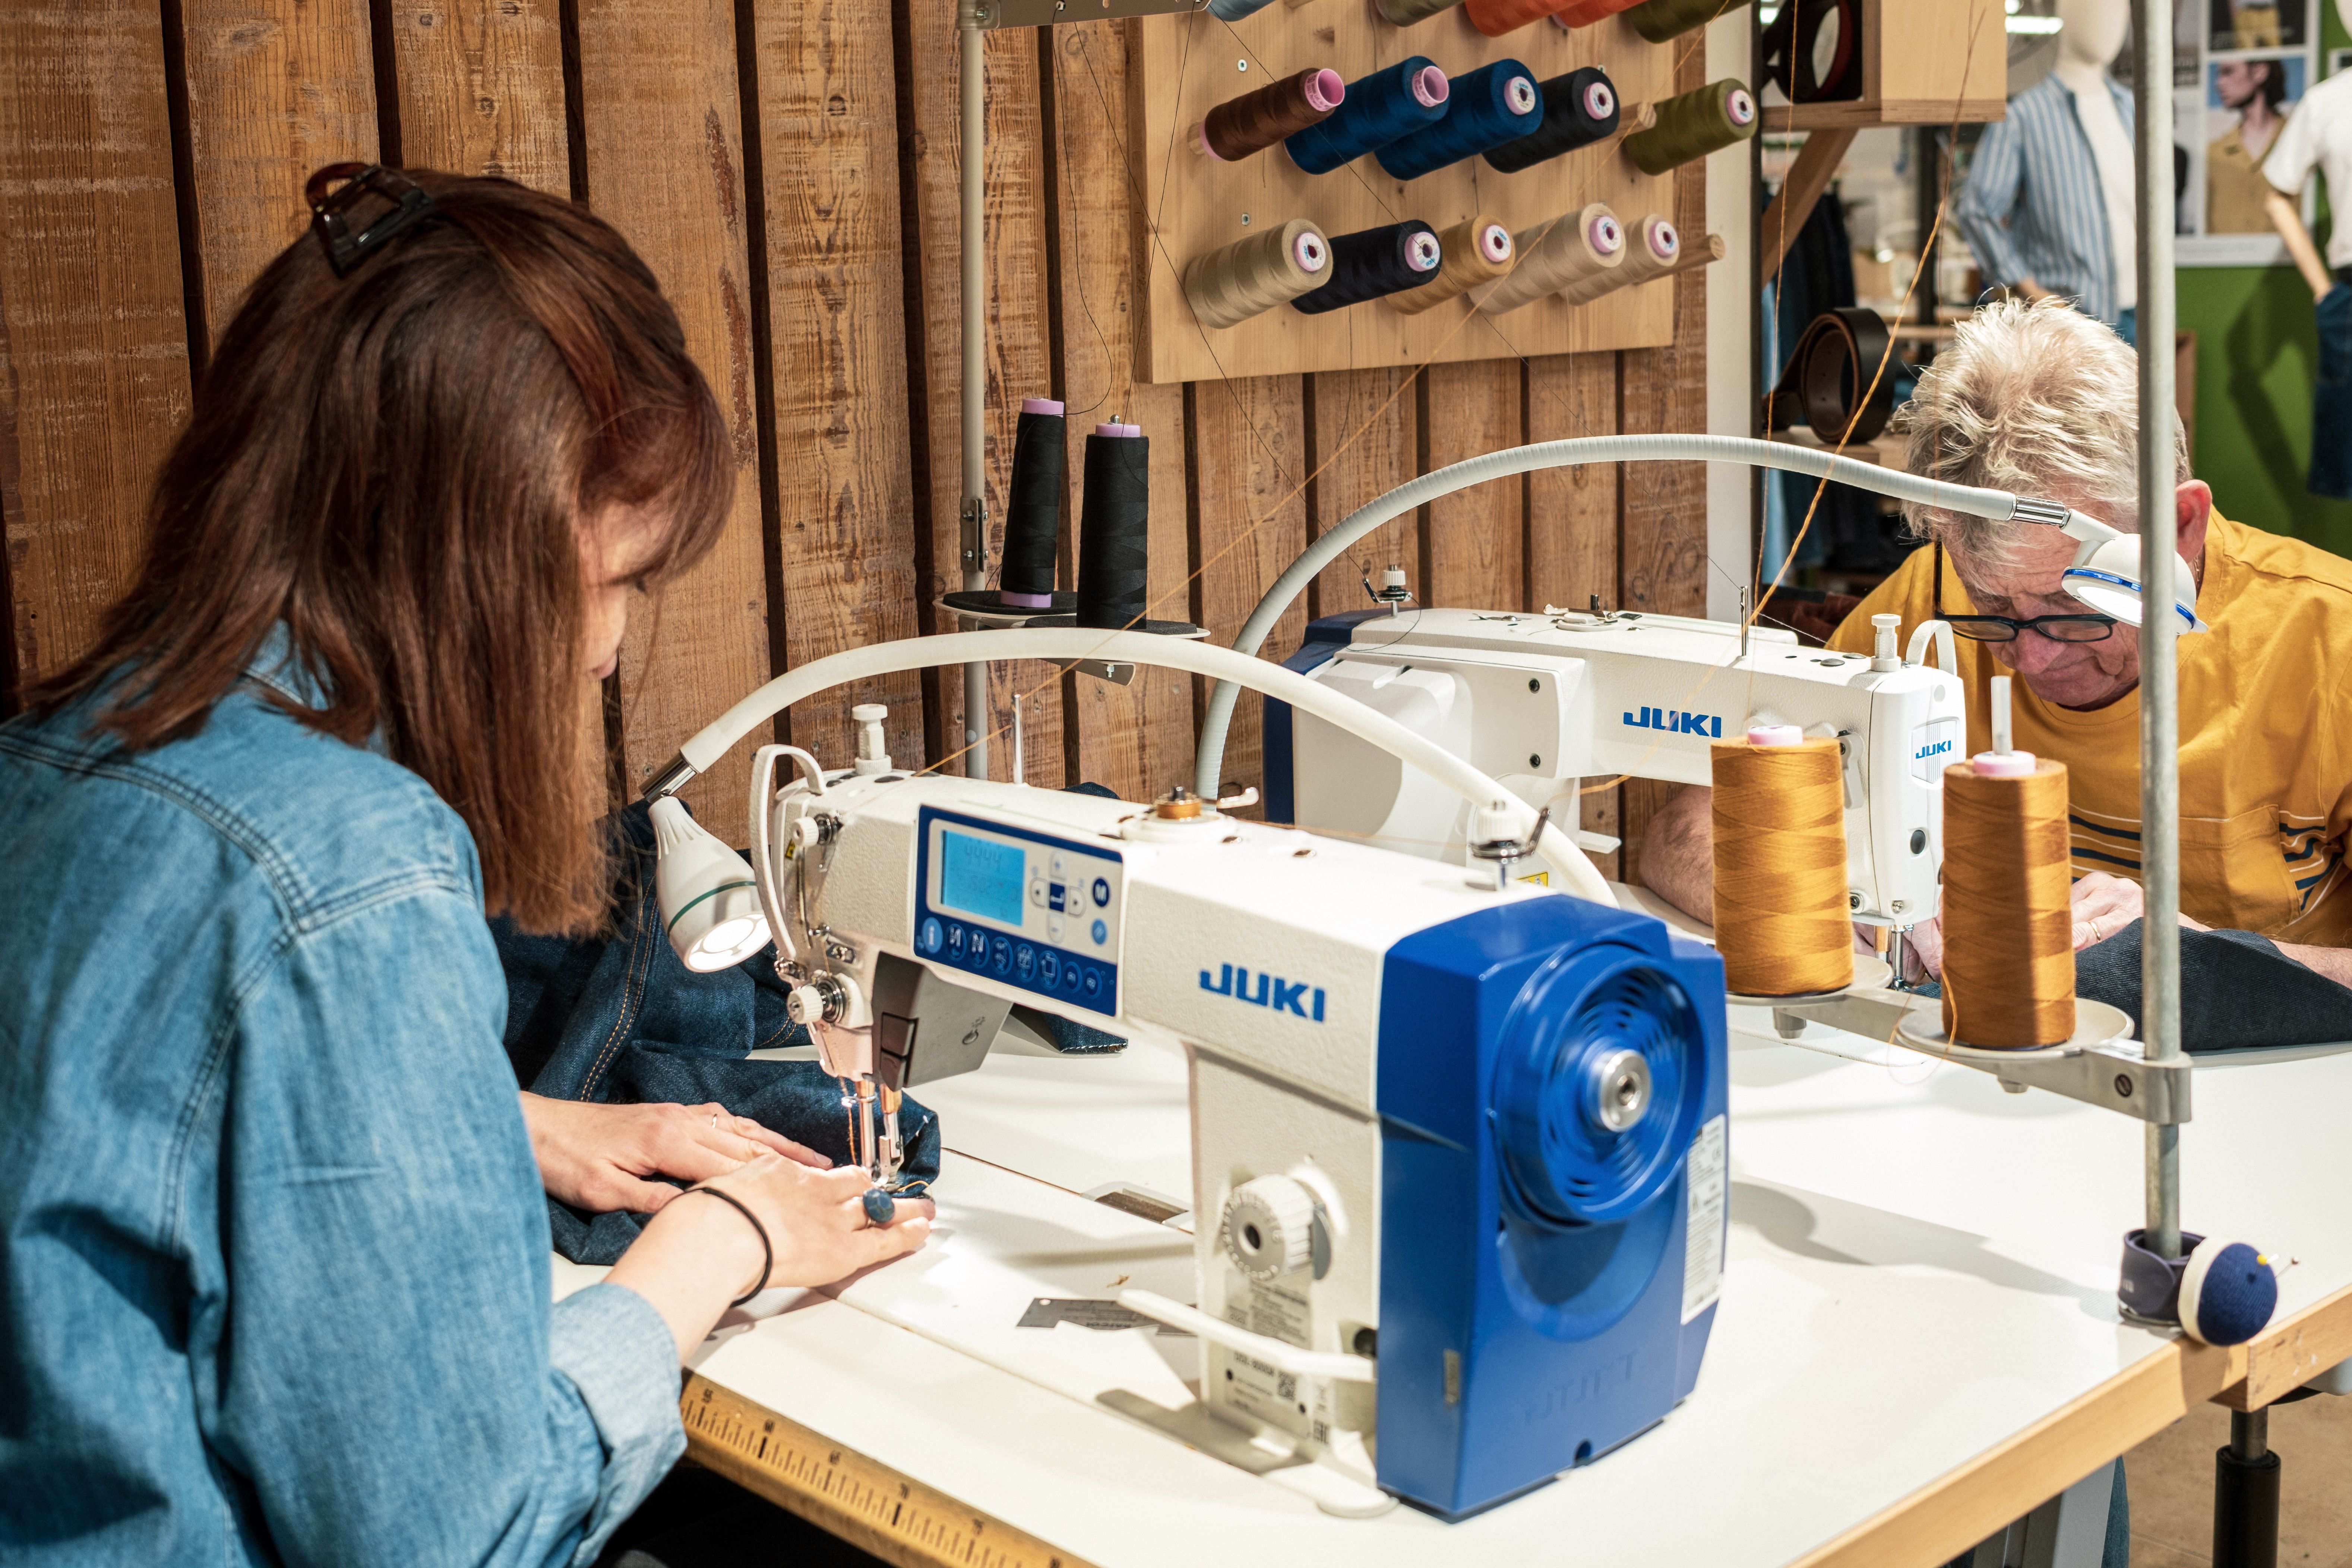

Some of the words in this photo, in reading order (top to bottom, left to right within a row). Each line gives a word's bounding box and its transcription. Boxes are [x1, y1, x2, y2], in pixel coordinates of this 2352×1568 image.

[1623, 706, 1722, 738] JUKI
[1916, 740, 1951, 759] JUKI
[1200, 962, 1325, 1022] JUKI
